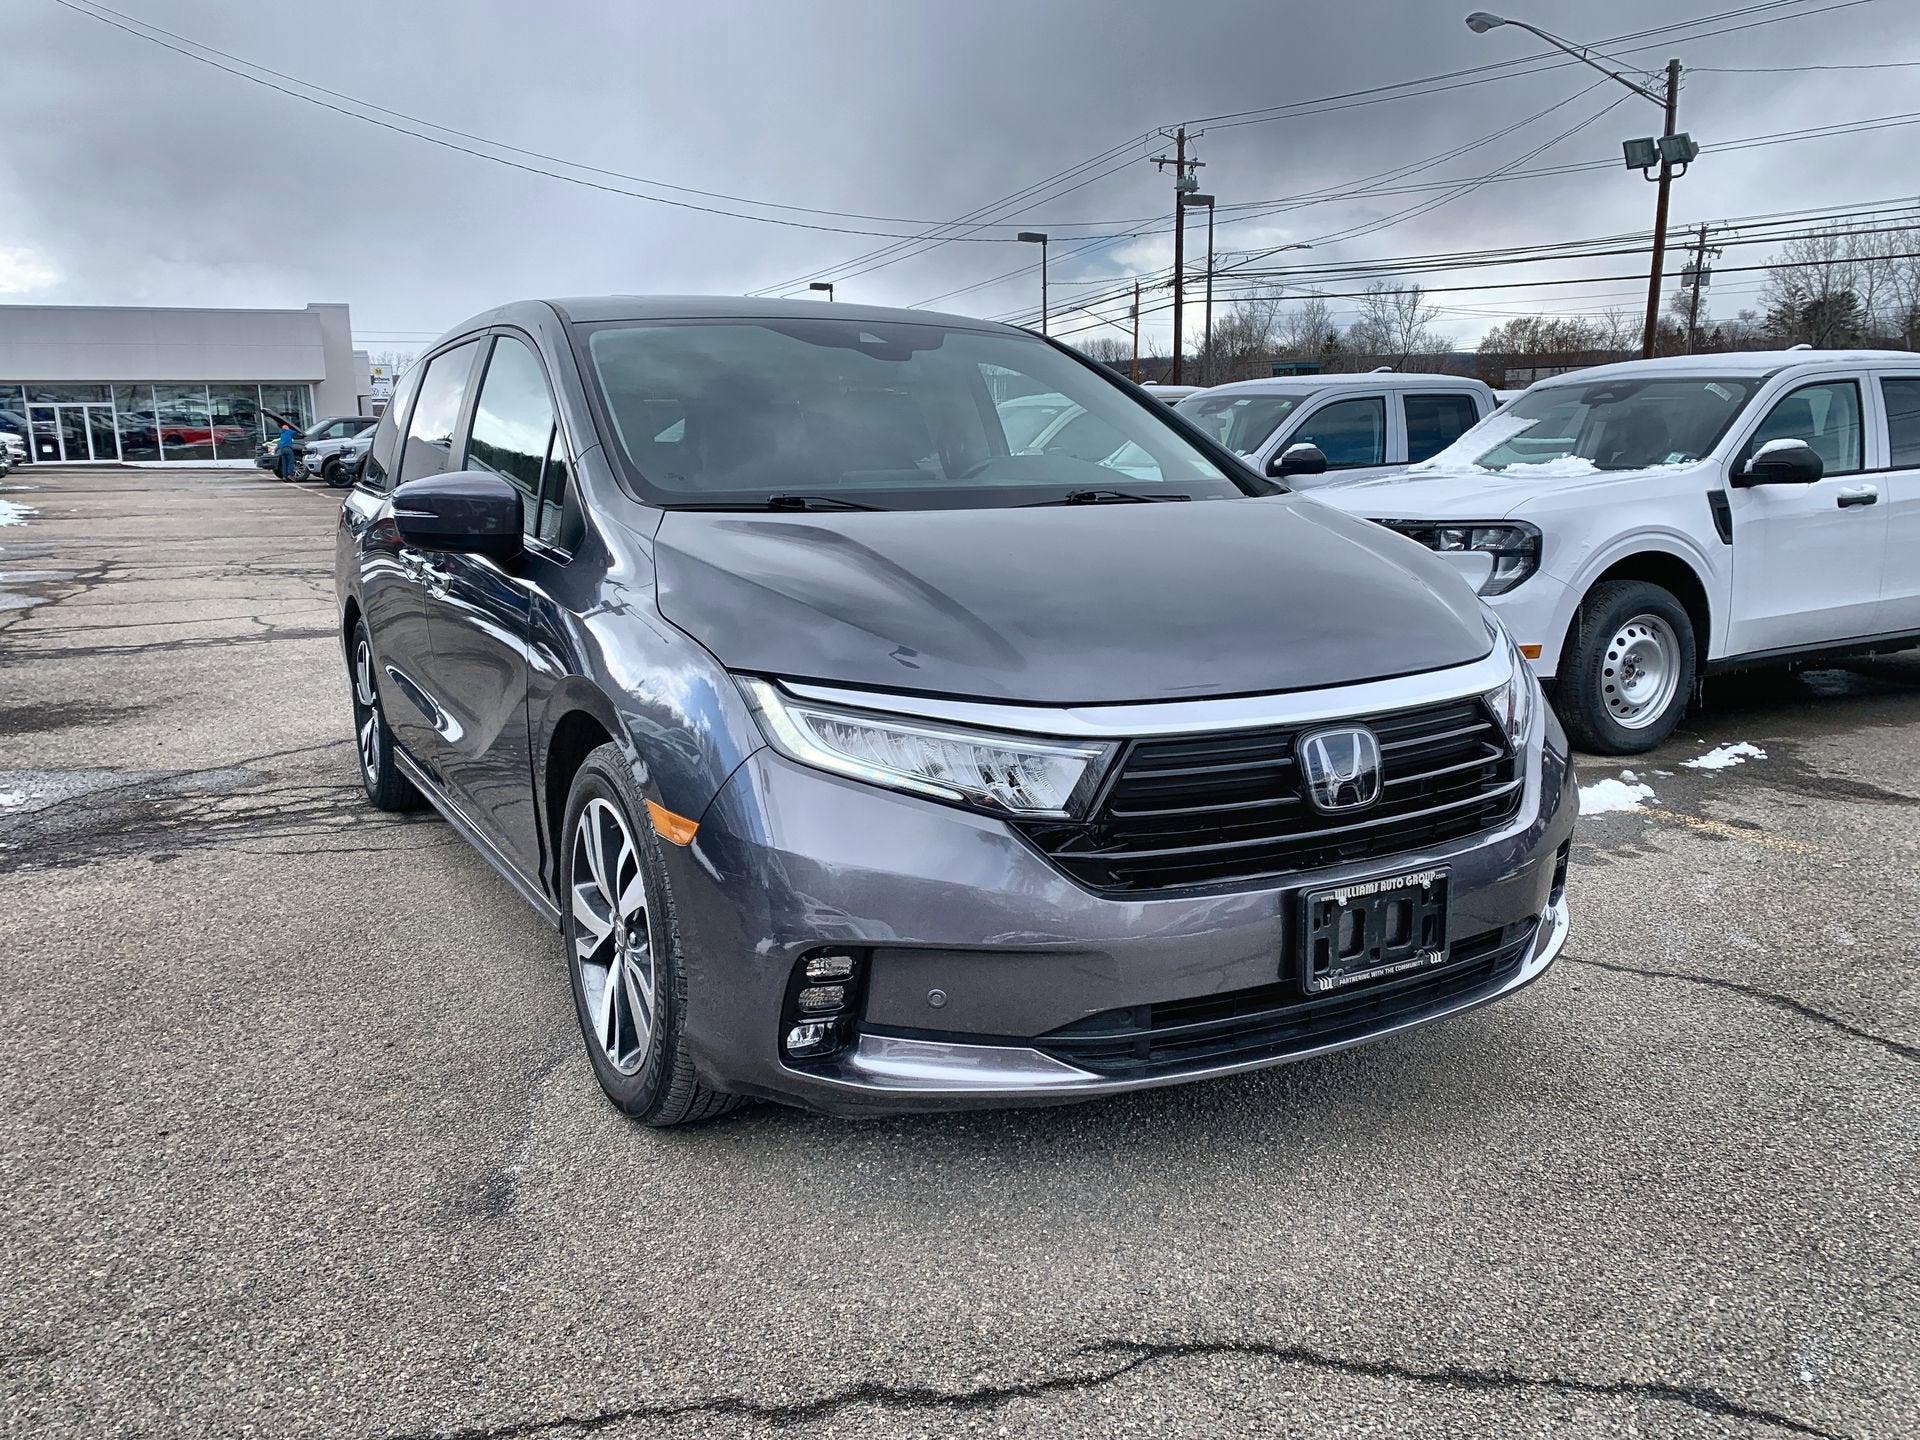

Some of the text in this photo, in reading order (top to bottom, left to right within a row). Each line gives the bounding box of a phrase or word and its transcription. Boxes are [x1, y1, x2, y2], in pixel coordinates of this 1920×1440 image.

[1380, 878, 1404, 892] AUTO
[1339, 960, 1424, 986] PARTNERING WITH THE COMMUNITY
